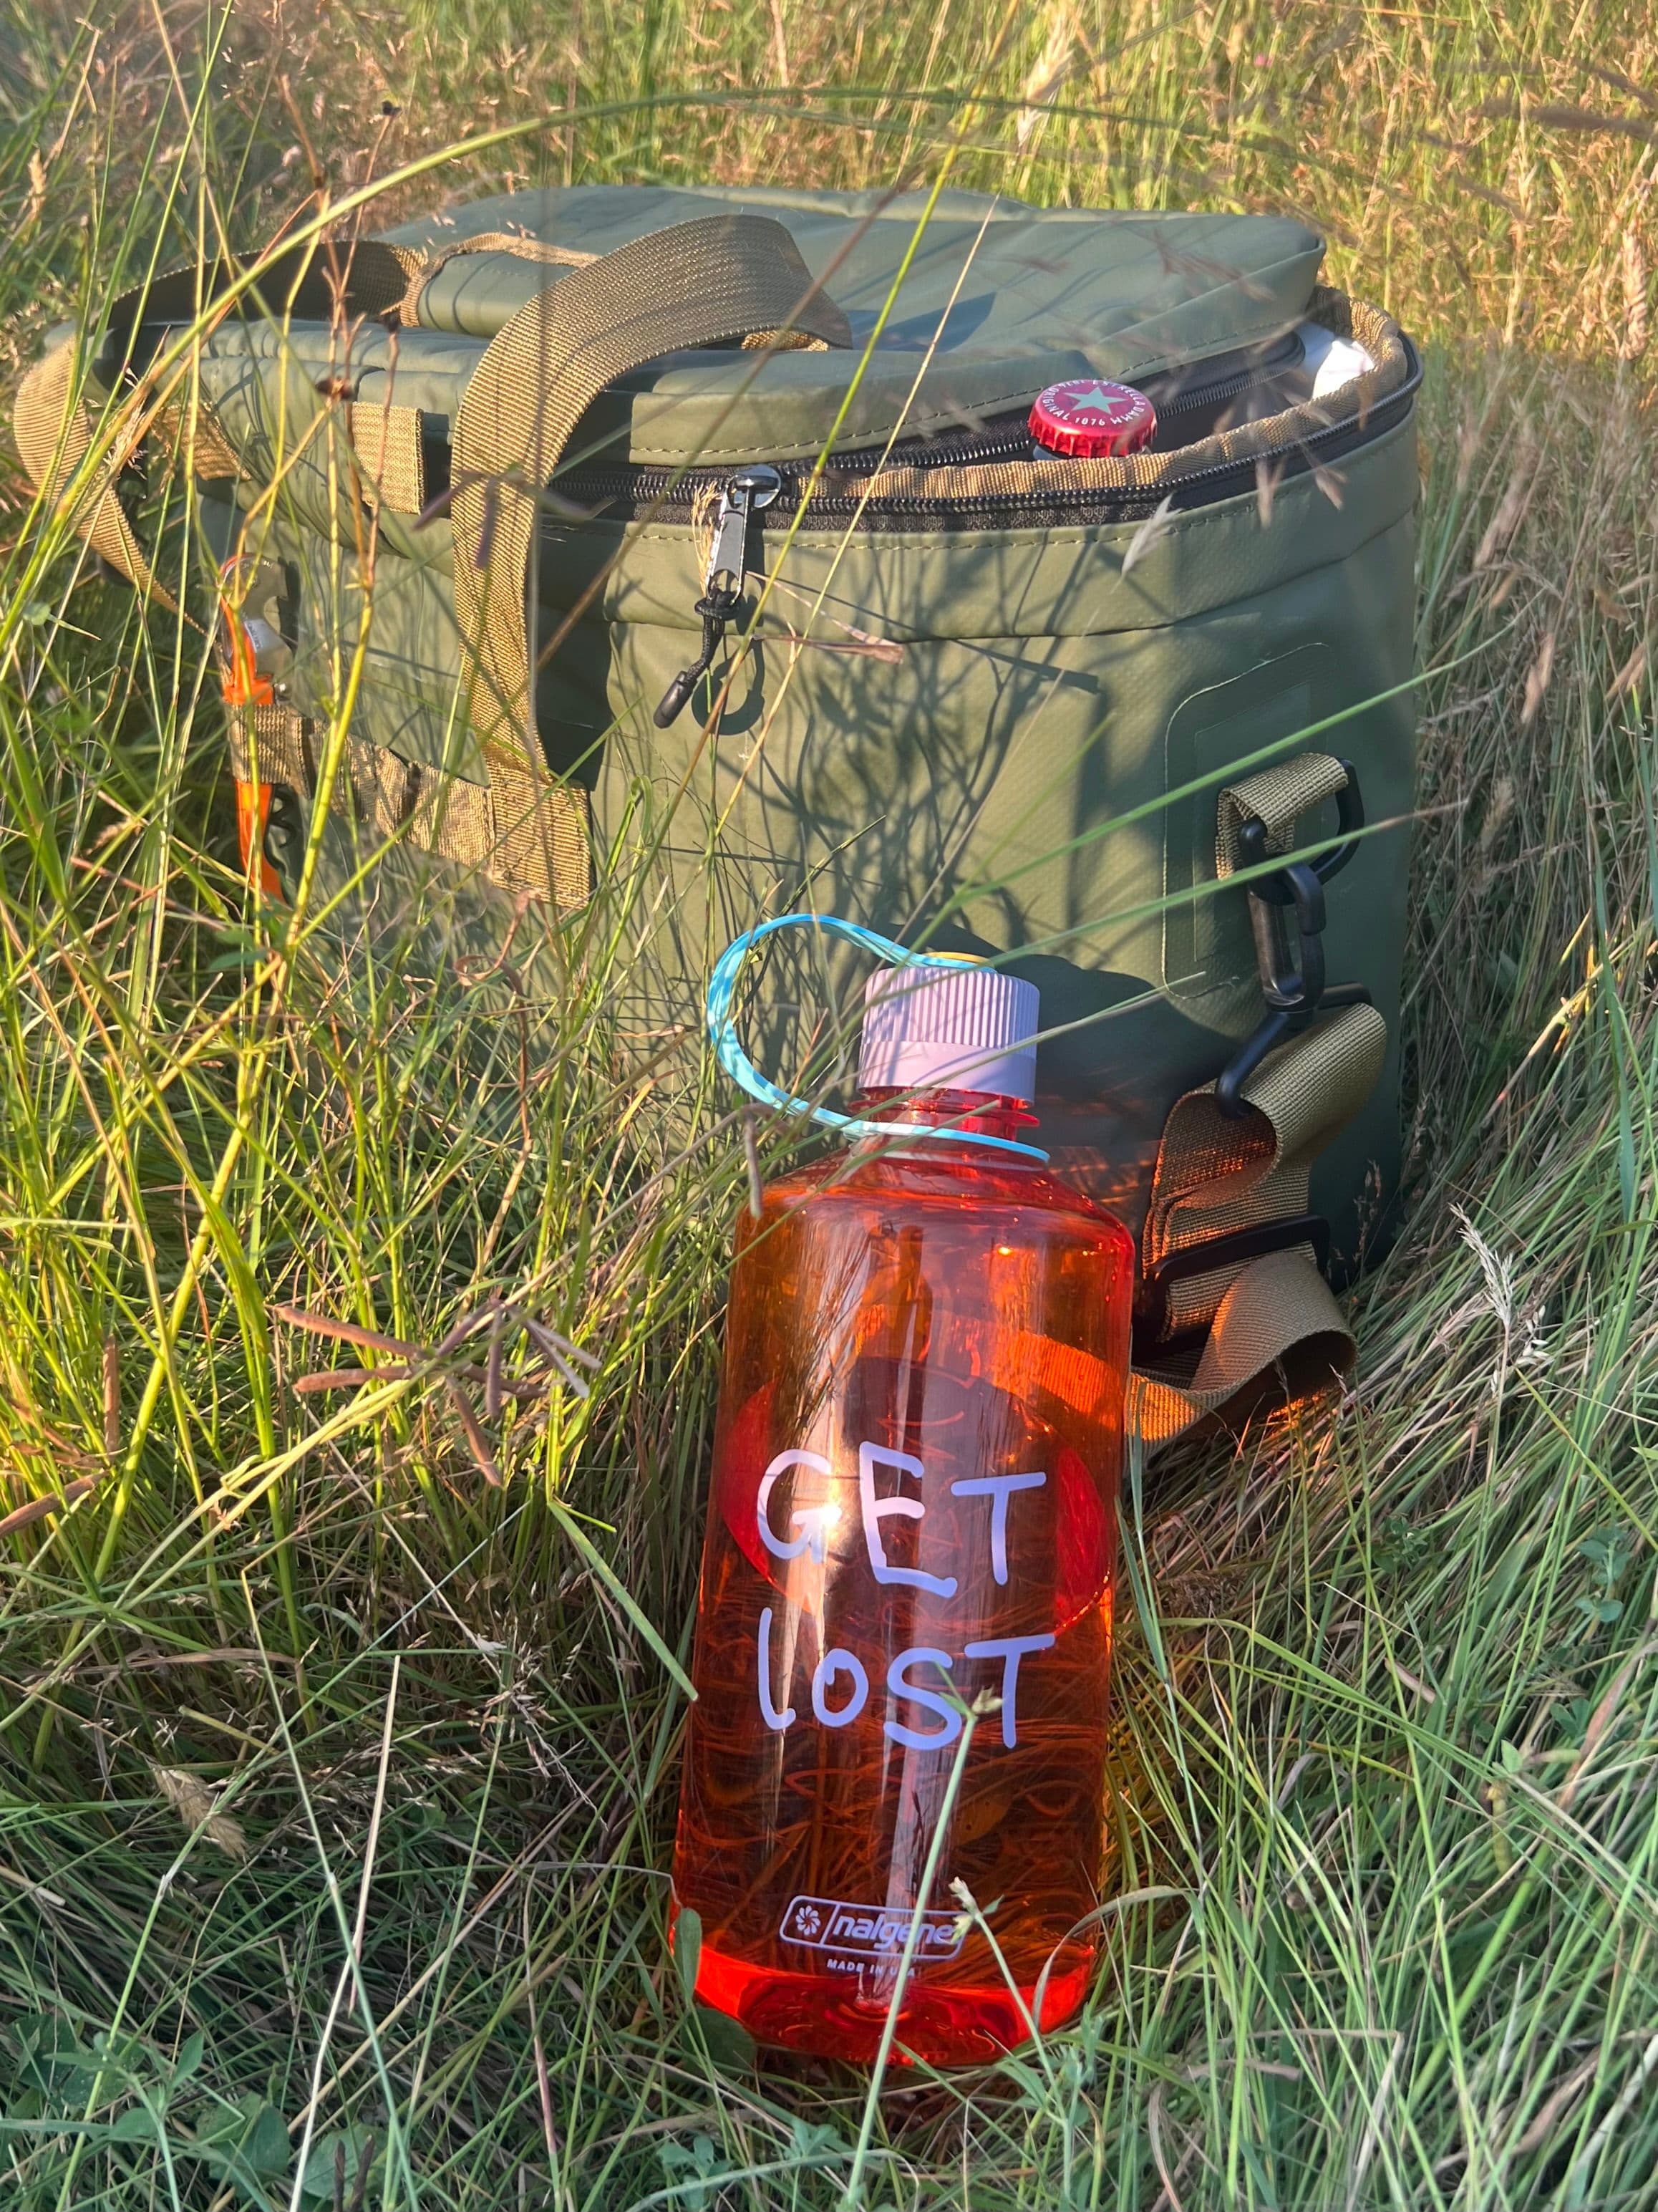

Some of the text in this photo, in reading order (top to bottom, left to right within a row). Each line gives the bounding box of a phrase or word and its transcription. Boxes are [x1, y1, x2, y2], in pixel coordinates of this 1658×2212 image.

[1042, 387, 1070, 420] ORIGINAL
[1092, 380, 1145, 425] ESTRELLA DAMM
[757, 1441, 1047, 1598] GET
[757, 1607, 1056, 1751] LOST
[833, 1913, 955, 1949] nalgene
[826, 1959, 915, 1977] MADE IN UA
